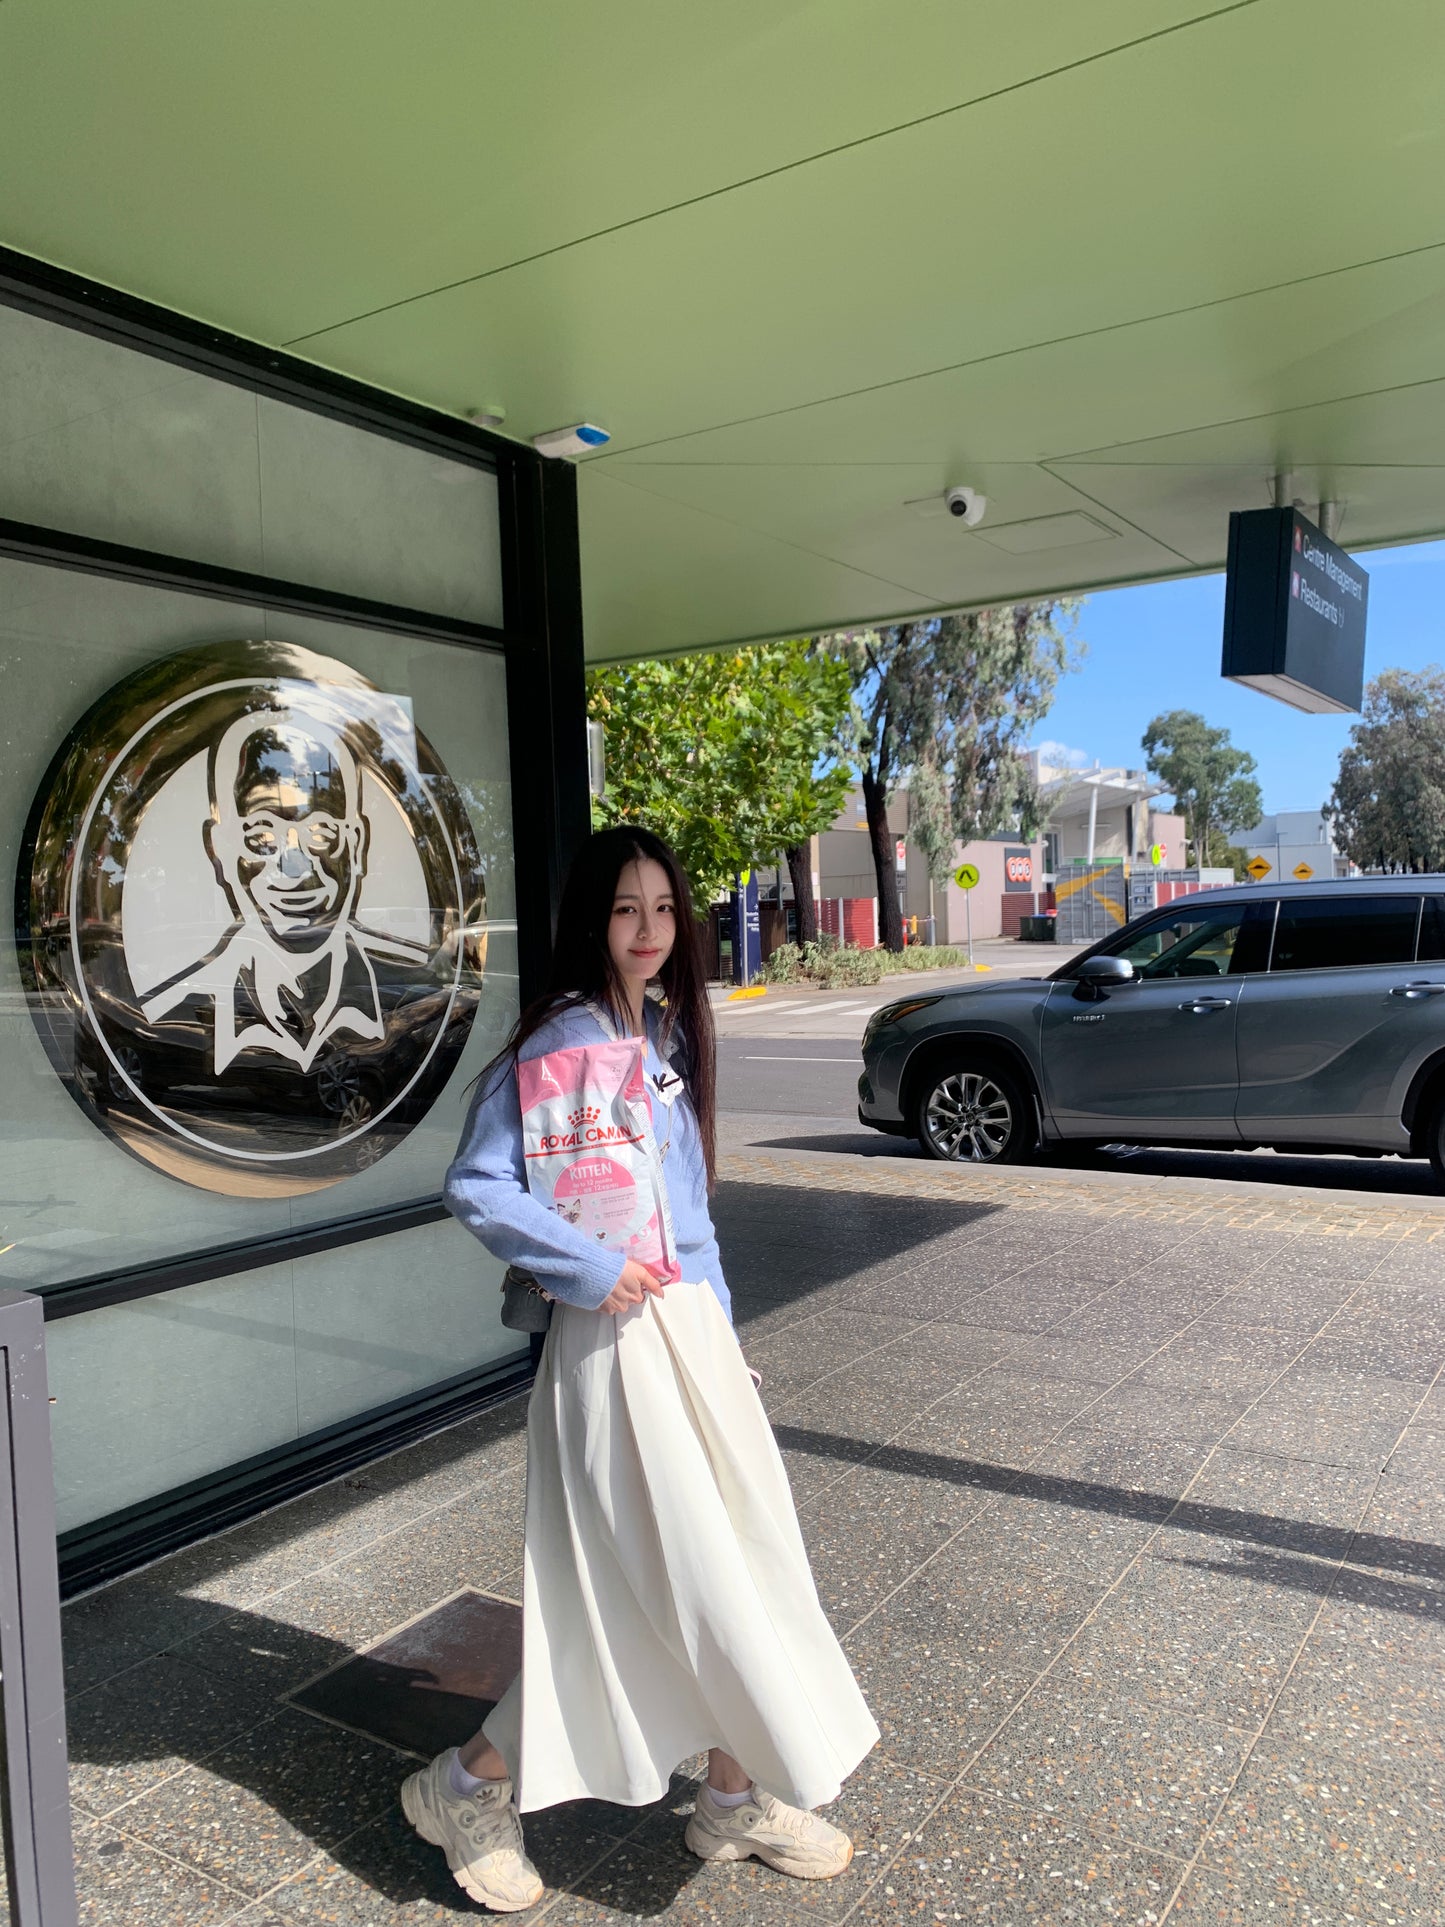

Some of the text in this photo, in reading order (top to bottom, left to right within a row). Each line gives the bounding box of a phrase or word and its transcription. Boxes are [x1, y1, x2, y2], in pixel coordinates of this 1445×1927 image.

[1303, 534, 1362, 601] Centre Management
[1301, 578, 1338, 625] Restaurants
[540, 1125, 632, 1149] ROYAL CANIN
[569, 1162, 613, 1181] KITTEN
